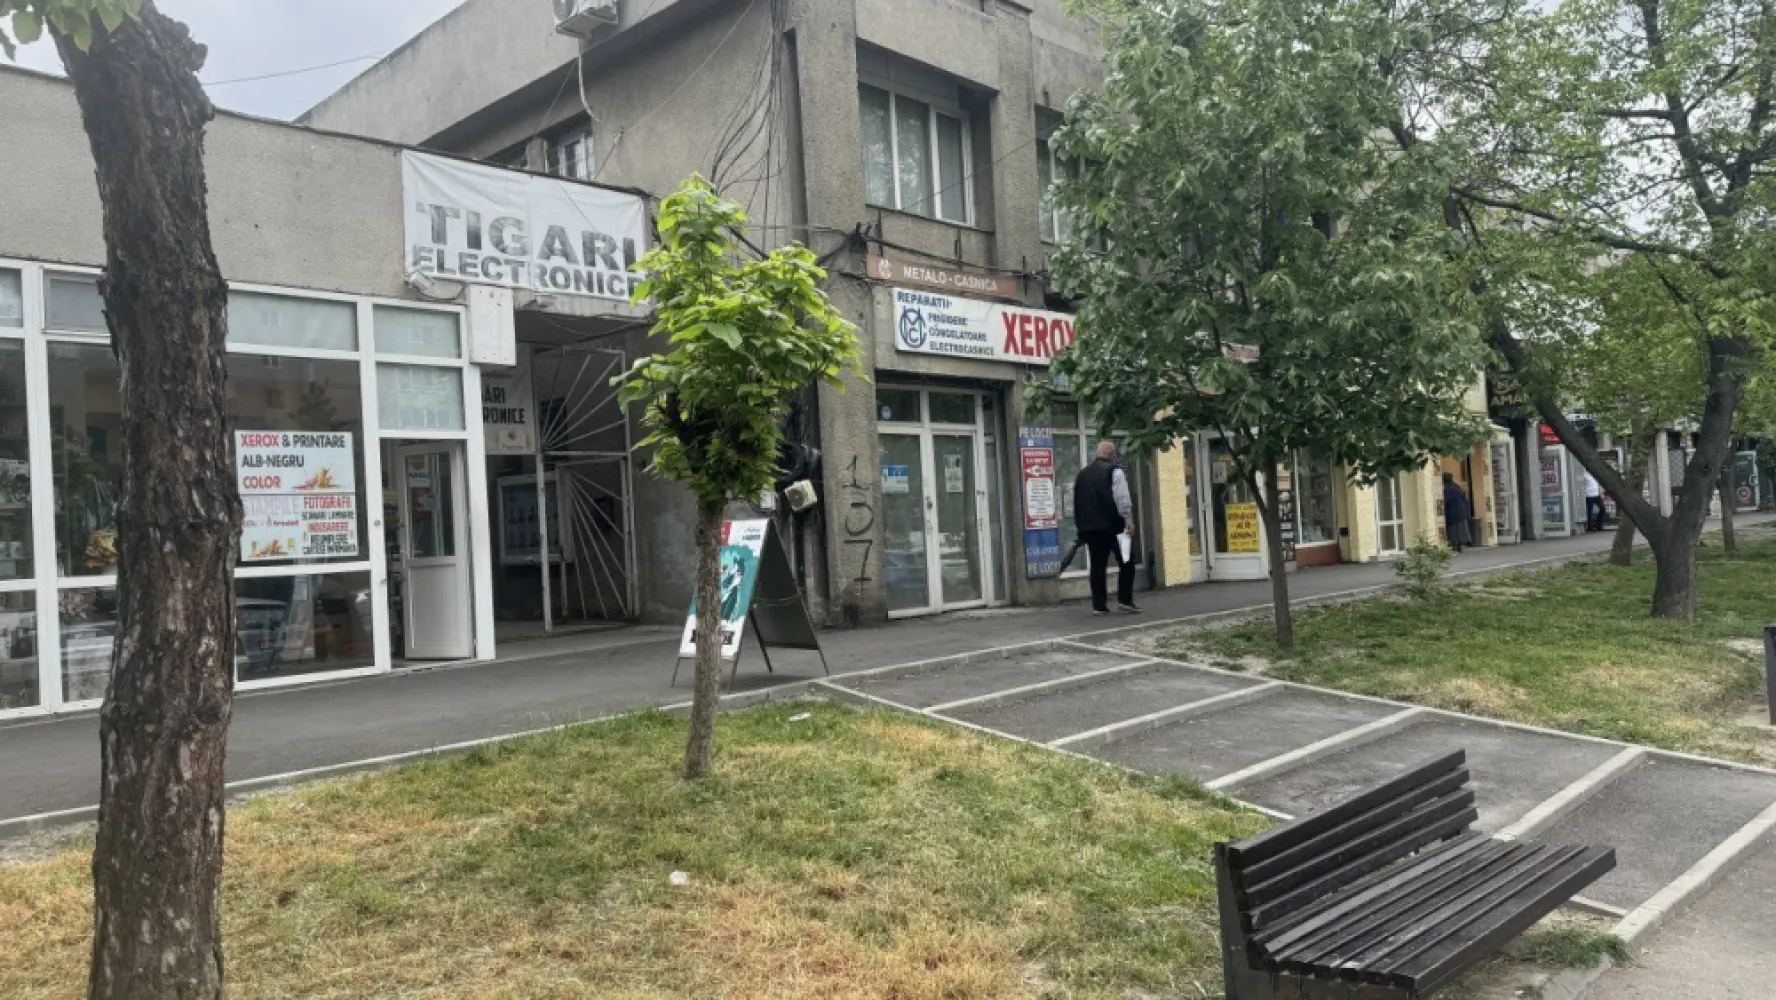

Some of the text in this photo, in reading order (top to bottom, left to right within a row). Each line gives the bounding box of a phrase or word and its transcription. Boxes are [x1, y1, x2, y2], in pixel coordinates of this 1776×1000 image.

[415, 201, 636, 273] TIGARI
[483, 407, 525, 424] RONICE
[241, 433, 346, 448] XEROX & PRINTARE
[241, 454, 304, 467] ALB-NEGRU
[243, 475, 281, 488] COLOR
